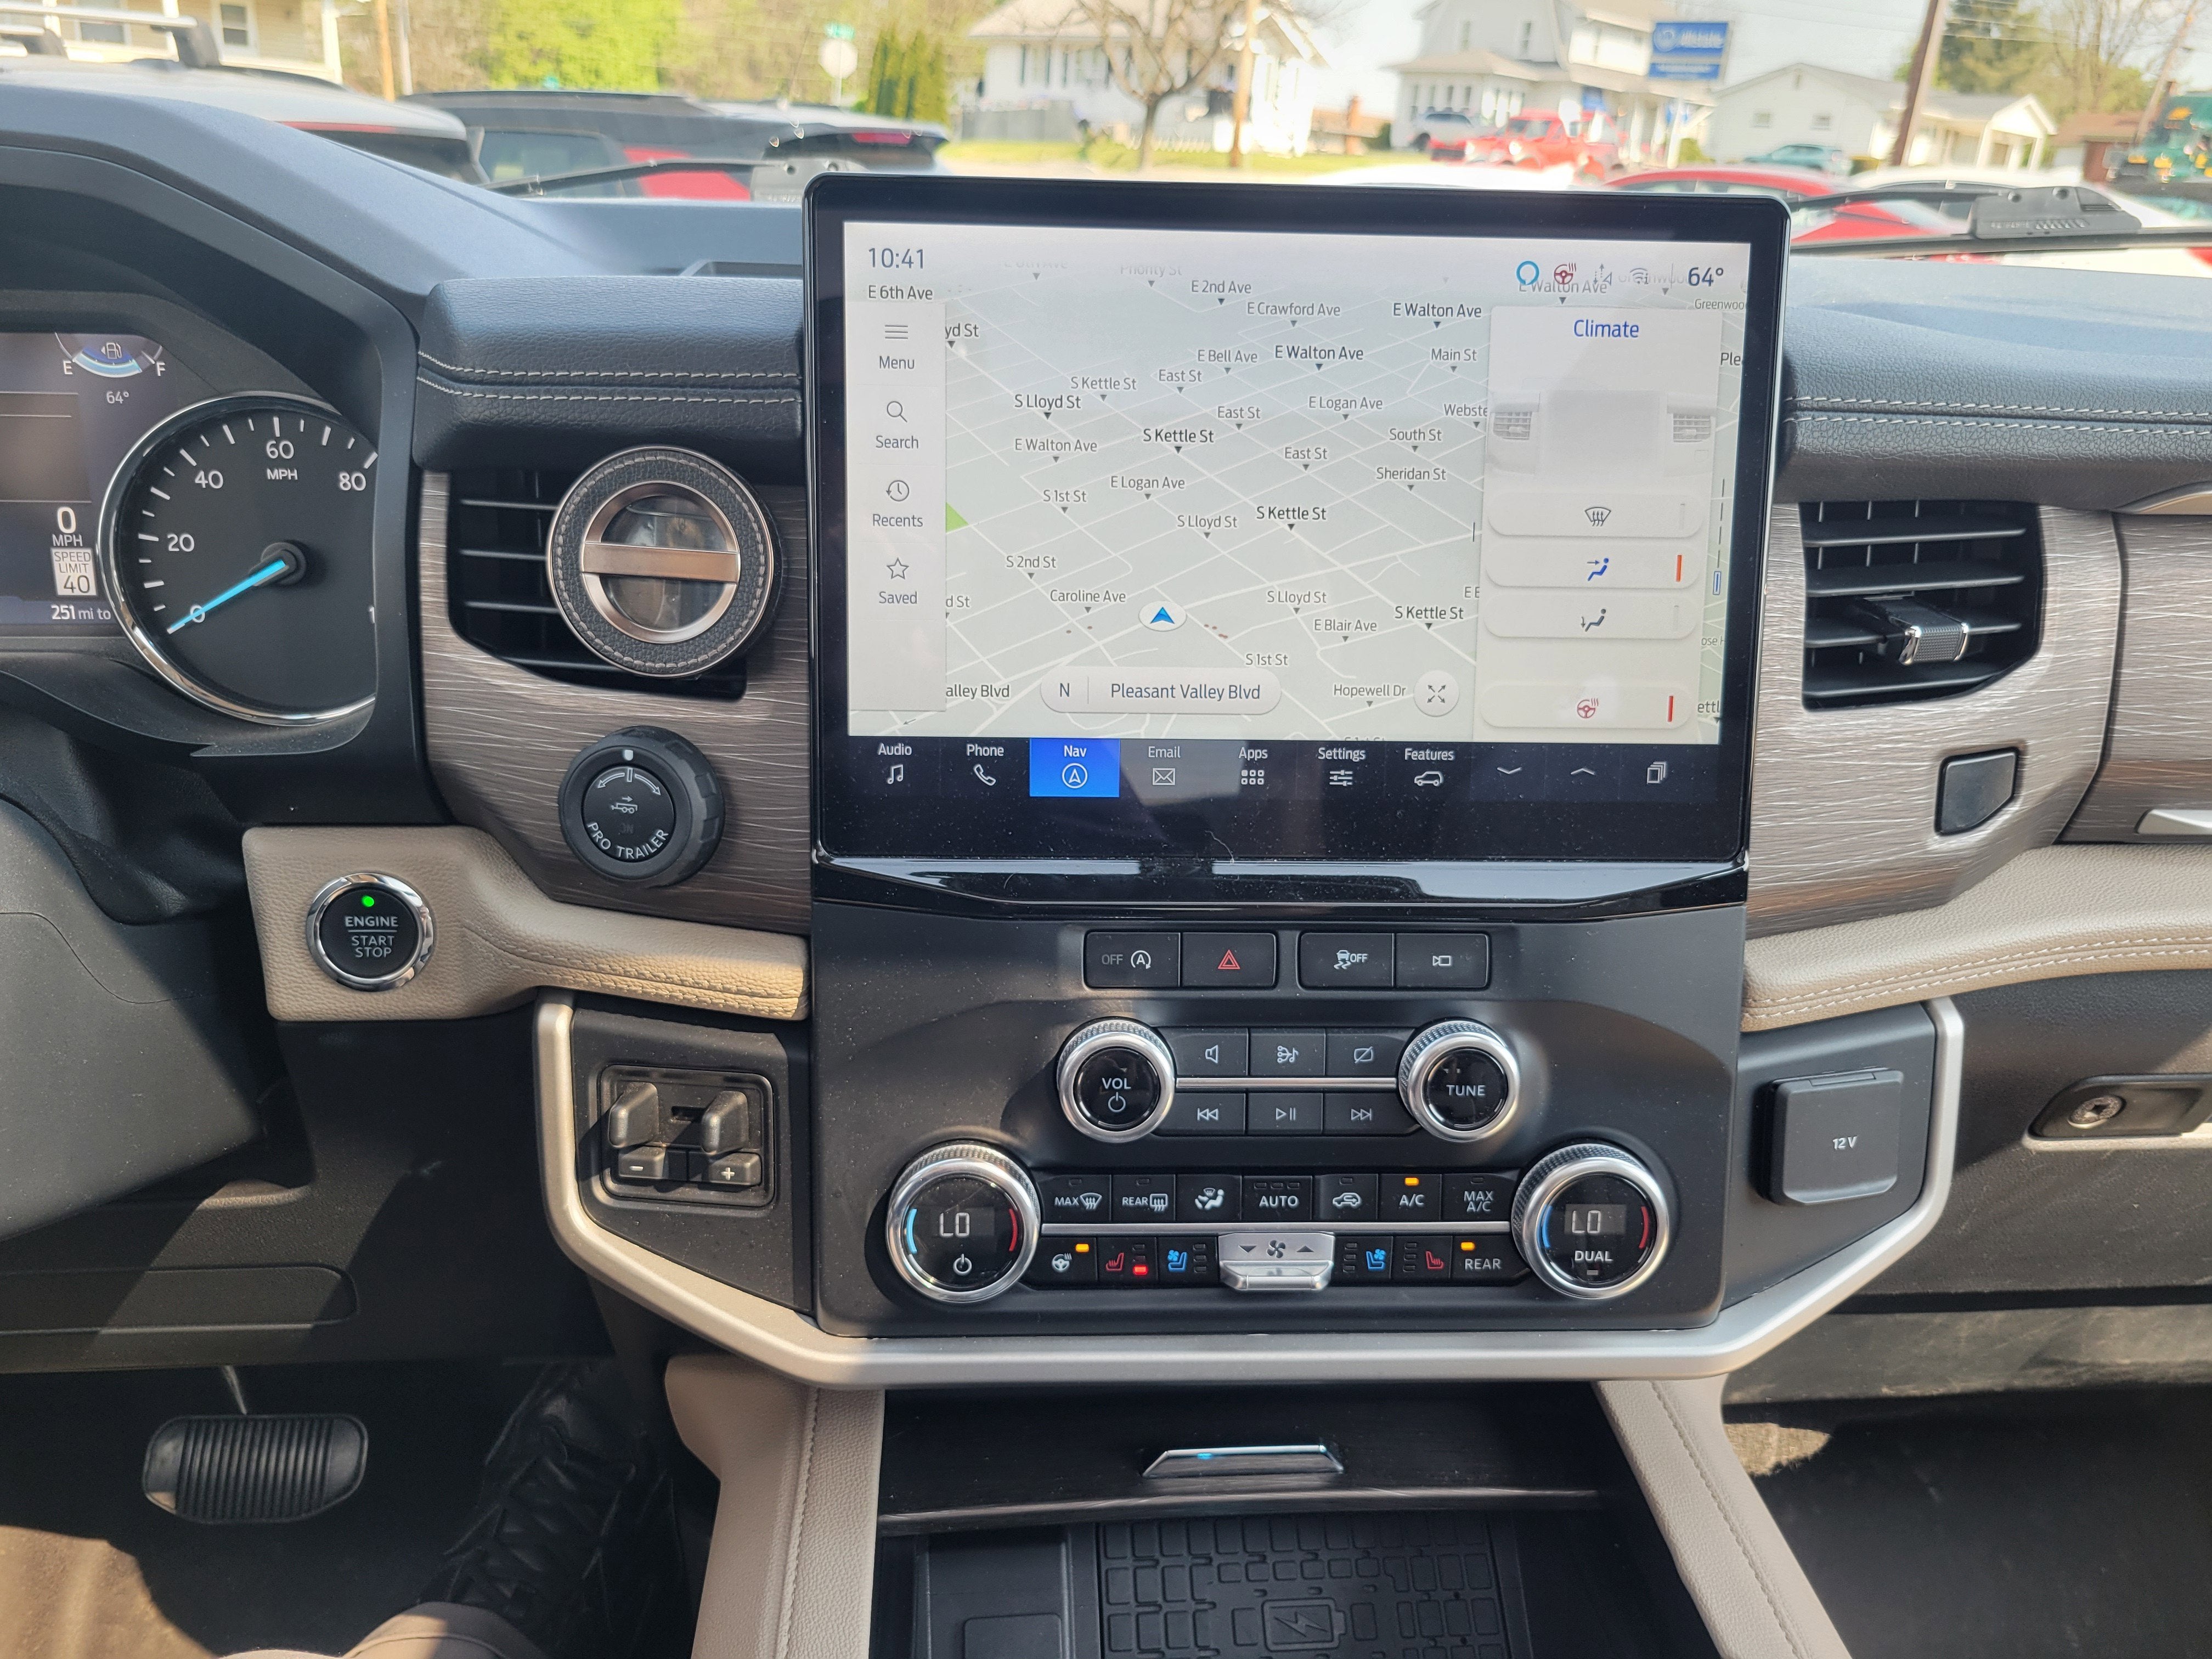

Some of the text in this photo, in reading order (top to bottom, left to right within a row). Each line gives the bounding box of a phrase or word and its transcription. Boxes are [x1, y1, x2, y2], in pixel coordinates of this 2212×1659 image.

[868, 247, 924, 269] 10:41
[1688, 267, 1724, 287] 64°
[869, 285, 933, 300] E 6th Ave
[1191, 280, 1251, 294] E 2nd Ave
[1582, 281, 1607, 294] Ave
[1248, 302, 1340, 316] E Crawford Ave
[1393, 303, 1482, 318] E Walton Ave
[964, 324, 979, 338] St
[1573, 320, 1639, 338] Climate
[1198, 349, 1257, 363] E Bell Ave
[1275, 345, 1364, 360] E Walton Ave
[1431, 348, 1477, 361] Main St
[63, 361, 72, 375] E
[156, 362, 165, 376] F
[879, 356, 915, 370] Menu
[1159, 369, 1202, 382] East St
[1071, 376, 1137, 390] S Kettle St
[106, 391, 129, 403] 64°
[1014, 394, 1081, 411] S Lloyd St
[1309, 396, 1383, 411] E Logan Ave
[1218, 406, 1261, 419] East St
[1143, 428, 1214, 443] S Kettle St
[1390, 428, 1442, 441] South St
[876, 436, 919, 449] Search
[1015, 439, 1097, 452] E Walton Ave
[266, 441, 294, 459] 60
[1285, 447, 1328, 460] East St
[195, 471, 224, 489] 40
[267, 469, 298, 480] MPH
[1376, 467, 1447, 481] Sheridan St
[339, 472, 366, 491] 80
[1111, 476, 1185, 491] E Logan Ave
[1043, 490, 1087, 503] S 1st St
[1256, 506, 1327, 520] S Kettle St
[57, 506, 76, 534] 0
[873, 514, 923, 527] Recents
[1177, 515, 1238, 529] S Lloyd St
[52, 534, 83, 546] MPH
[167, 534, 195, 552] 20
[55, 551, 91, 562] SPEED
[1006, 556, 1057, 568] S 2nd St
[59, 563, 89, 573] LIMIT
[64, 575, 90, 594] 40
[879, 591, 917, 604] Saved
[1050, 589, 1126, 603] Caroline Ave
[1267, 591, 1327, 605] S Lloyd St
[1464, 586, 1471, 598] E
[957, 596, 970, 608] St
[51, 605, 111, 620] 251 mi to
[190, 605, 205, 623] 0
[1395, 606, 1464, 619] S Kettle St
[1314, 619, 1377, 631] E Blair Ave
[1246, 653, 1288, 665] S 1st St
[981, 685, 1009, 697] Blvd
[1060, 683, 1070, 697] N
[1111, 684, 1260, 702] Pleasant Valley Blvd
[1334, 684, 1406, 698] Hopewell Dr
[878, 743, 912, 756] Audio
[966, 744, 1005, 757] Phone
[1064, 745, 1087, 757] Nav
[1148, 746, 1181, 758] Email
[1238, 747, 1268, 760] Apps
[1318, 747, 1366, 762] Settings
[1404, 748, 1455, 761] Features
[587, 822, 669, 859] PRO TRAILER
[345, 916, 399, 928] ENGINE
[351, 935, 394, 946] START
[355, 947, 392, 958] STOP
[1101, 954, 1123, 964] OFF
[1350, 953, 1368, 963] OFF
[1102, 1078, 1131, 1090] VOL
[1446, 1085, 1485, 1096] TUNE
[1054, 1197, 1079, 1206] MAX
[1122, 1196, 1148, 1206] REAR
[1259, 1195, 1298, 1207] AUTO
[1400, 1194, 1424, 1207] A/C
[1464, 1191, 1494, 1201] MAX
[1466, 1201, 1491, 1213] A/C
[1574, 1251, 1612, 1261] DUAL
[1465, 1259, 1500, 1270] REAR
